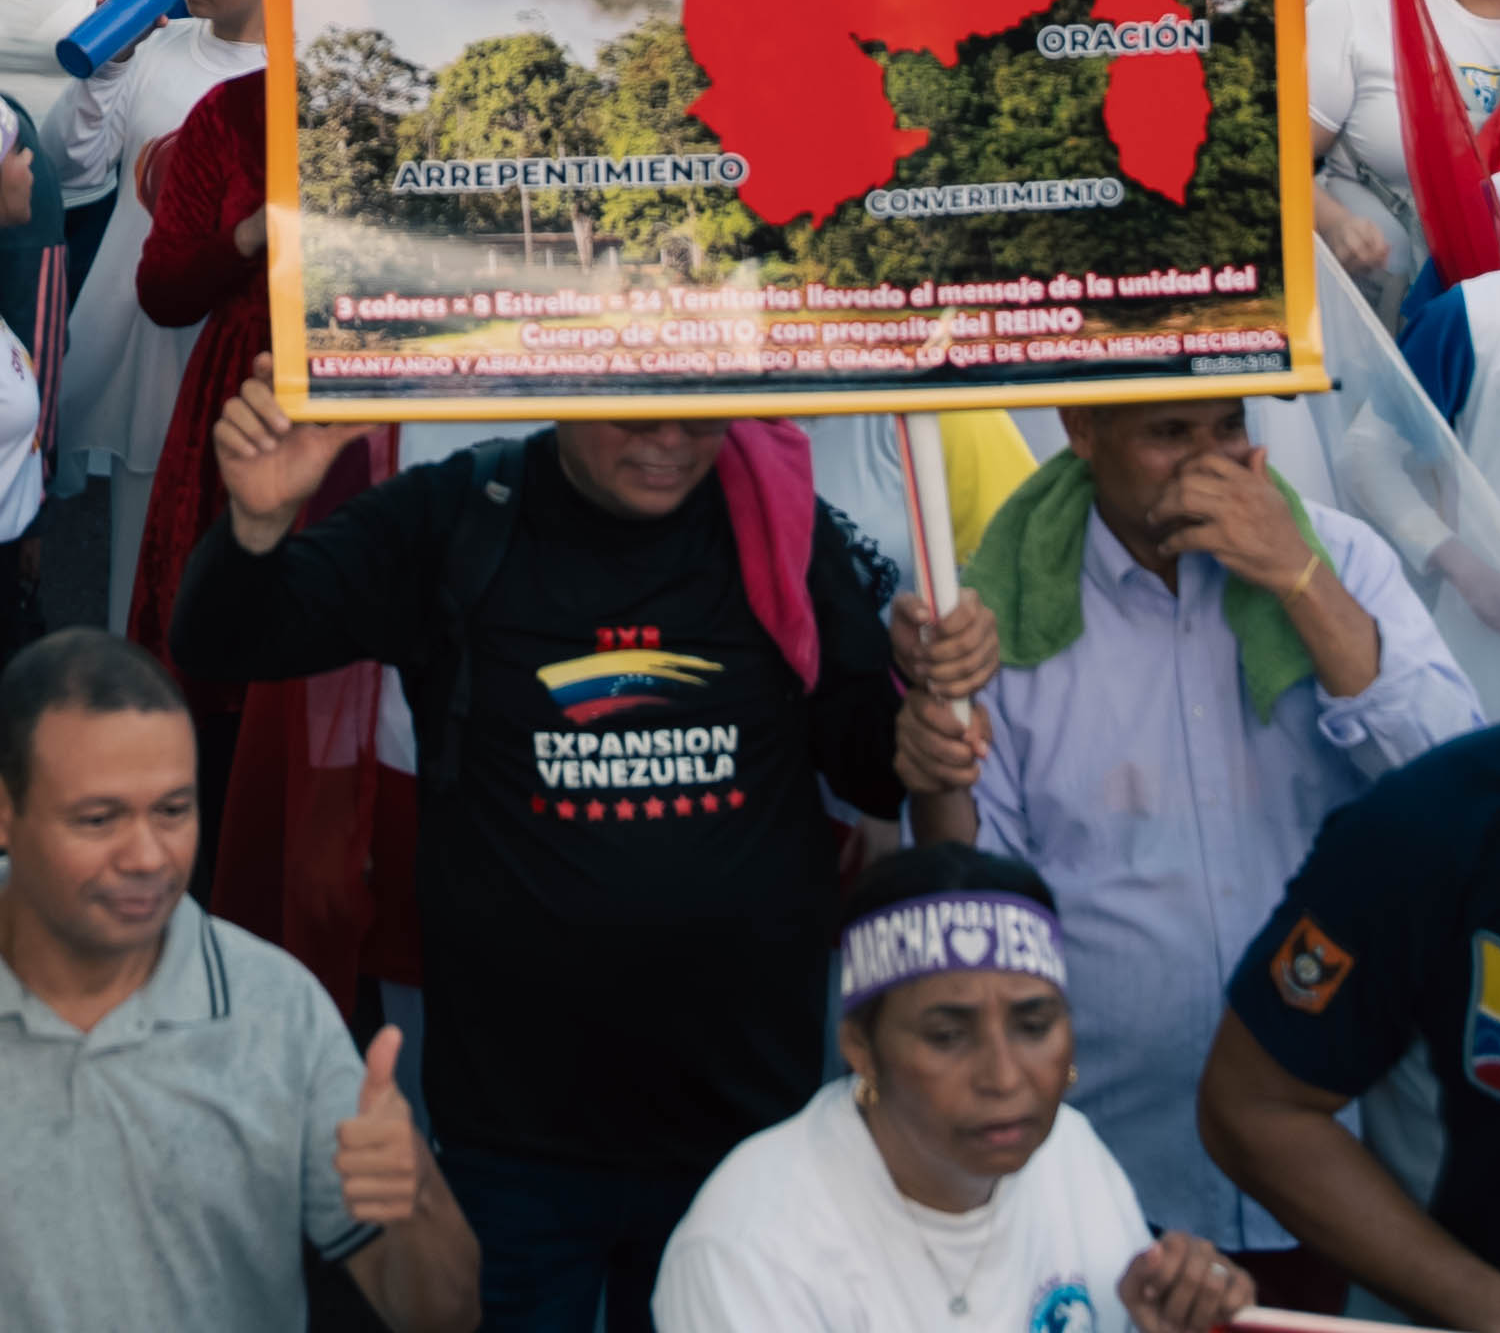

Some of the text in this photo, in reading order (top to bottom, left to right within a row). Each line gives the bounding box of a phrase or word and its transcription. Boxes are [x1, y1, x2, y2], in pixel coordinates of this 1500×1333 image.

[1036, 13, 1210, 59] ORACIÓN
[394, 153, 749, 194] ARREPENTIMIENTO
[865, 178, 1124, 218] CONVERTIMIENTO
[336, 295, 352, 319] 3
[358, 293, 449, 320] colores
[473, 293, 491, 318] 8
[495, 289, 601, 317] Estrellas
[629, 289, 664, 313] 24
[806, 280, 907, 310] llevado
[909, 279, 932, 307] el
[937, 276, 1044, 309] mensaje
[1047, 274, 1082, 301] de
[1085, 273, 1113, 299] la
[1115, 267, 1212, 298] unidad
[1214, 265, 1257, 293] del
[520, 321, 617, 351] Cuerpo
[620, 320, 656, 347] de
[769, 321, 817, 344] con
[820, 316, 942, 349] proposito
[945, 312, 990, 338] del
[993, 308, 1083, 334] REINO
[311, 355, 455, 375] LEVANTANDO
[456, 356, 471, 374] Y
[473, 354, 607, 374] ABRAZANDO
[610, 353, 638, 373] AL
[797, 348, 826, 370] DE
[829, 347, 914, 371] GRACIA,
[917, 345, 943, 366] LO
[945, 344, 991, 367] QUE
[993, 342, 1025, 363] DE
[1027, 338, 1106, 361] GRACIA
[1108, 335, 1179, 354] HEMOS
[533, 725, 739, 759] EXPANSION
[537, 754, 736, 789] VENEZUELA
[848, 904, 948, 994] MARCHA
